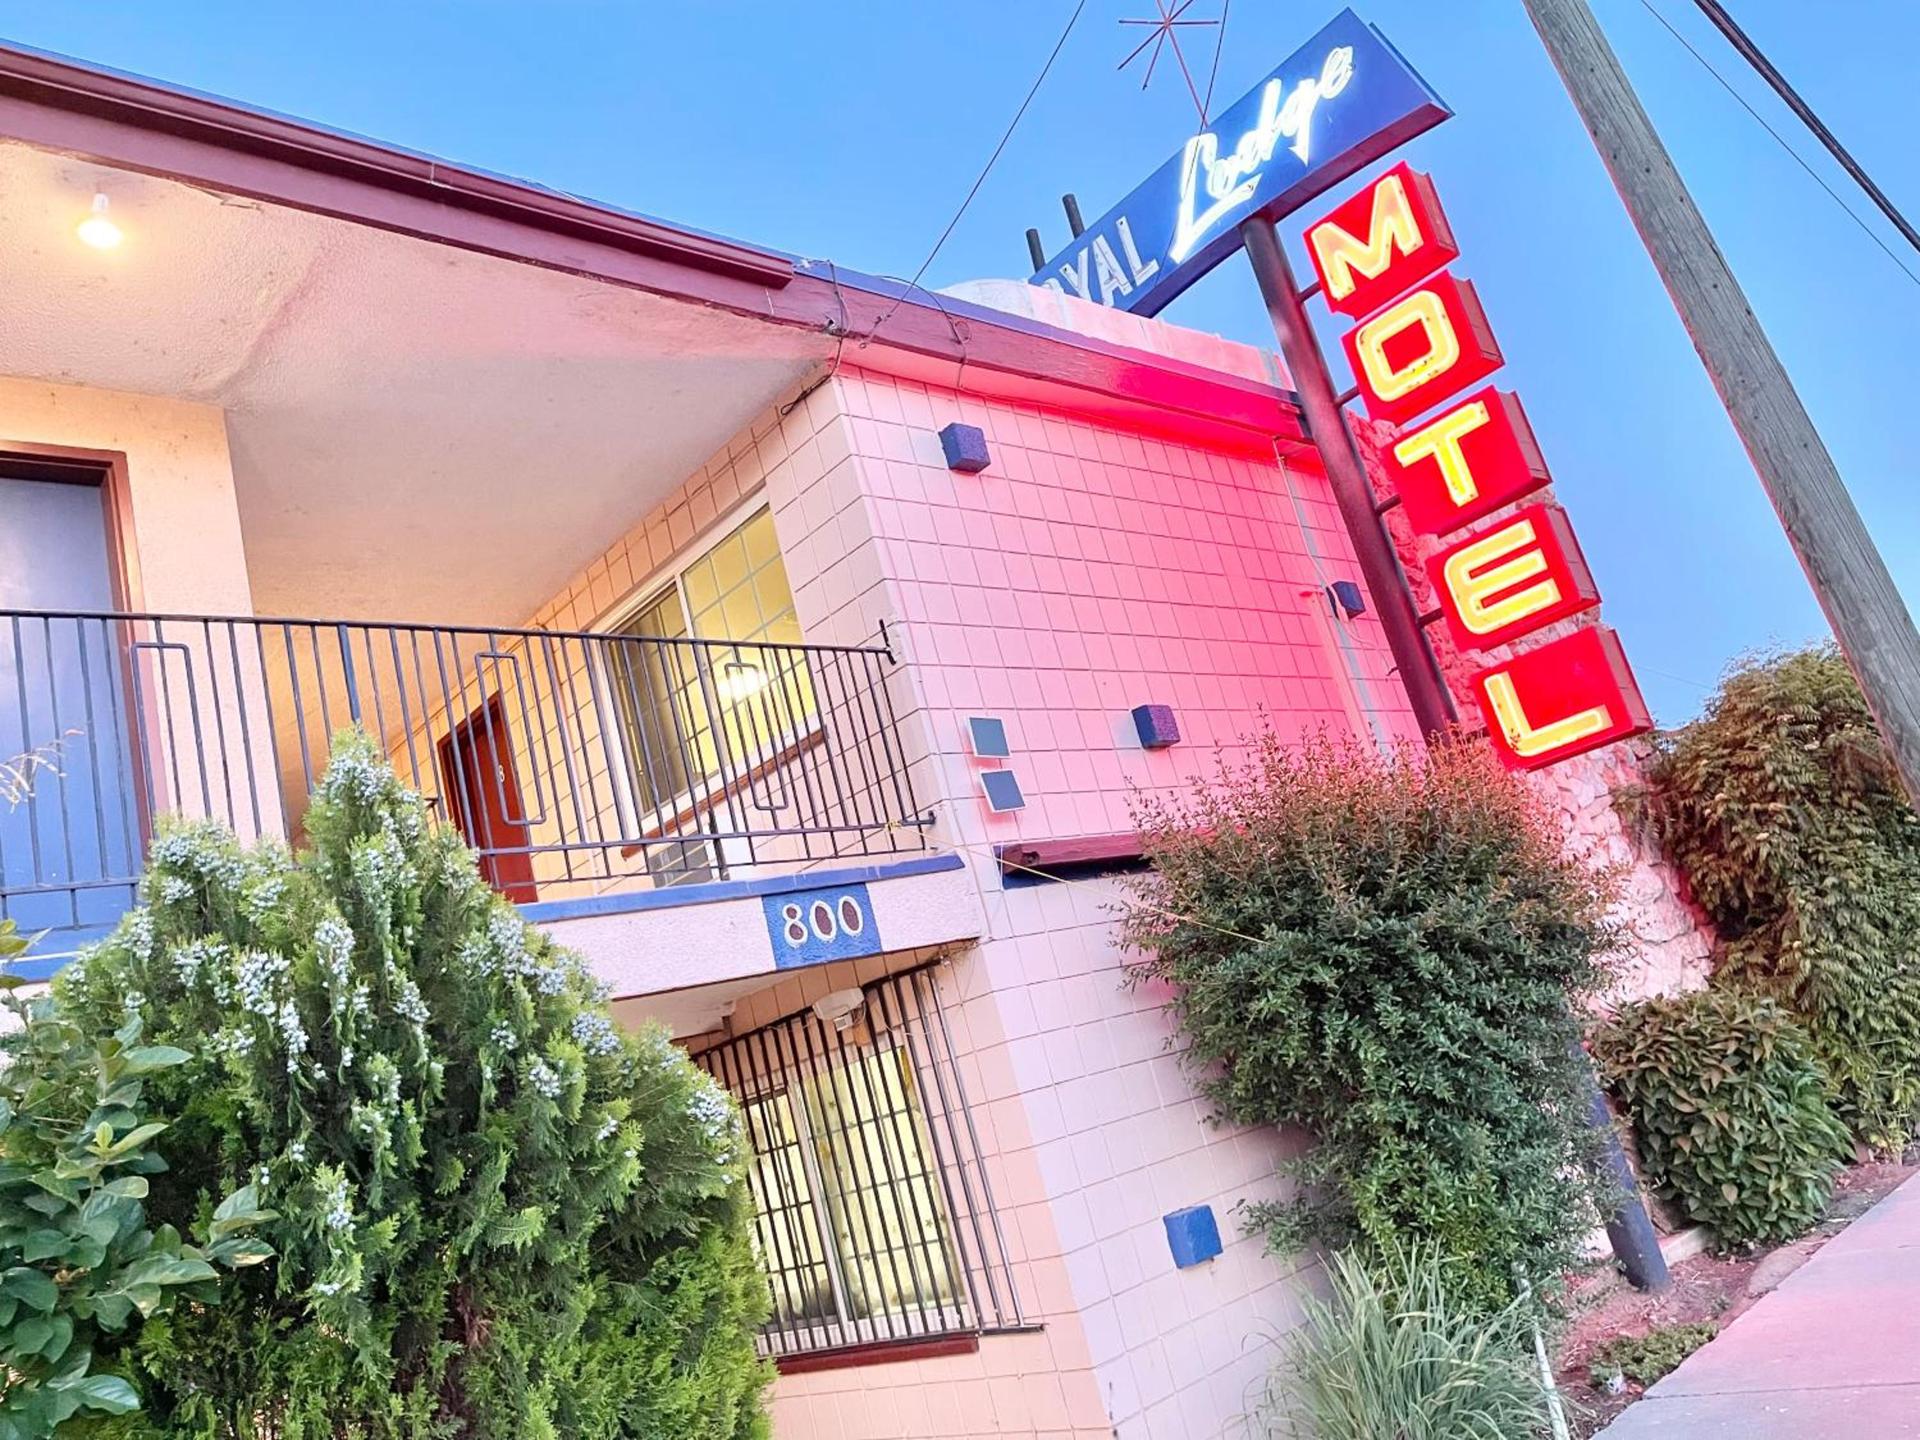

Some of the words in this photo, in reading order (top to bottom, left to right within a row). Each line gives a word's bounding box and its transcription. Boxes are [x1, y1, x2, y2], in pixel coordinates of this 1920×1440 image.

[1041, 215, 1160, 308] YAL
[1170, 46, 1354, 264] Lodge
[1310, 173, 1614, 758] MOTEL
[782, 895, 864, 950] 800
